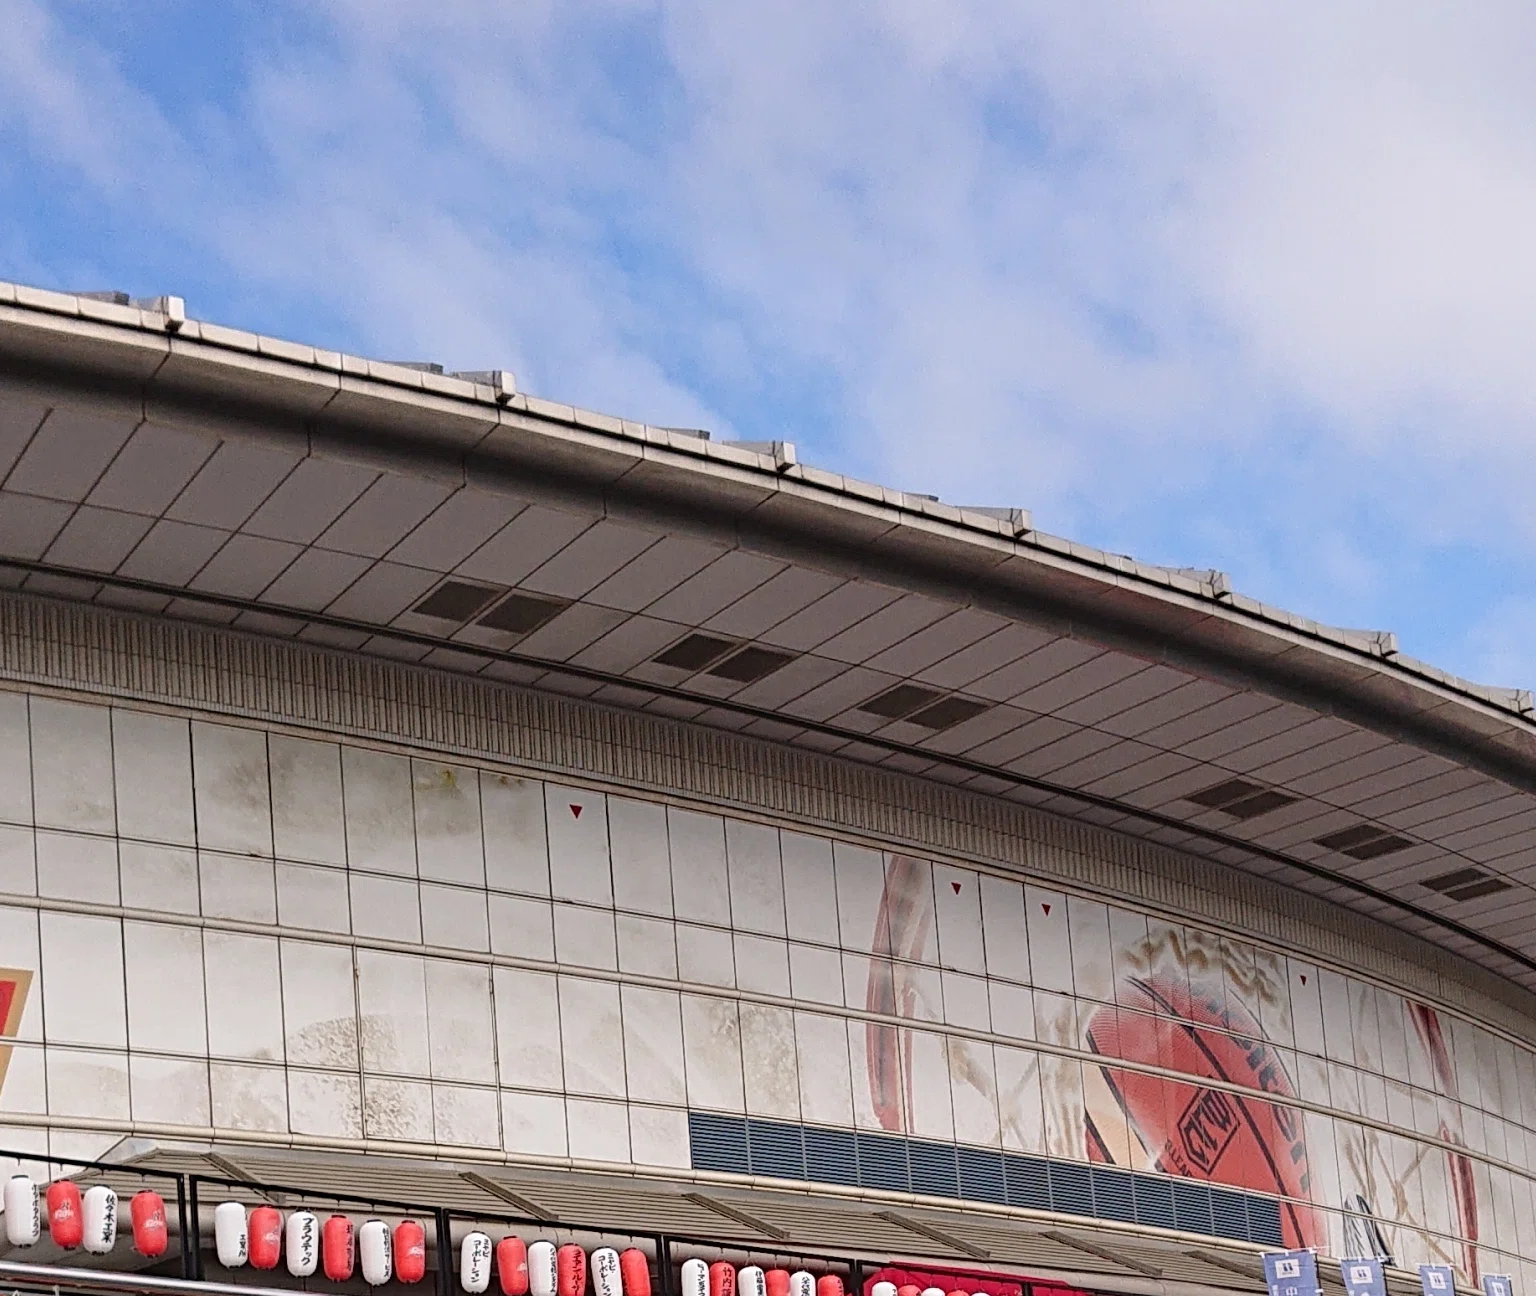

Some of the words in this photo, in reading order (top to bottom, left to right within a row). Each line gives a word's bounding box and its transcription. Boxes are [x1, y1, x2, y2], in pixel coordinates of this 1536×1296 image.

[100, 1193, 117, 1244] 佐々木工業
[300, 1216, 315, 1267] ブラウテック
[469, 1239, 482, 1283] コーポレーション
